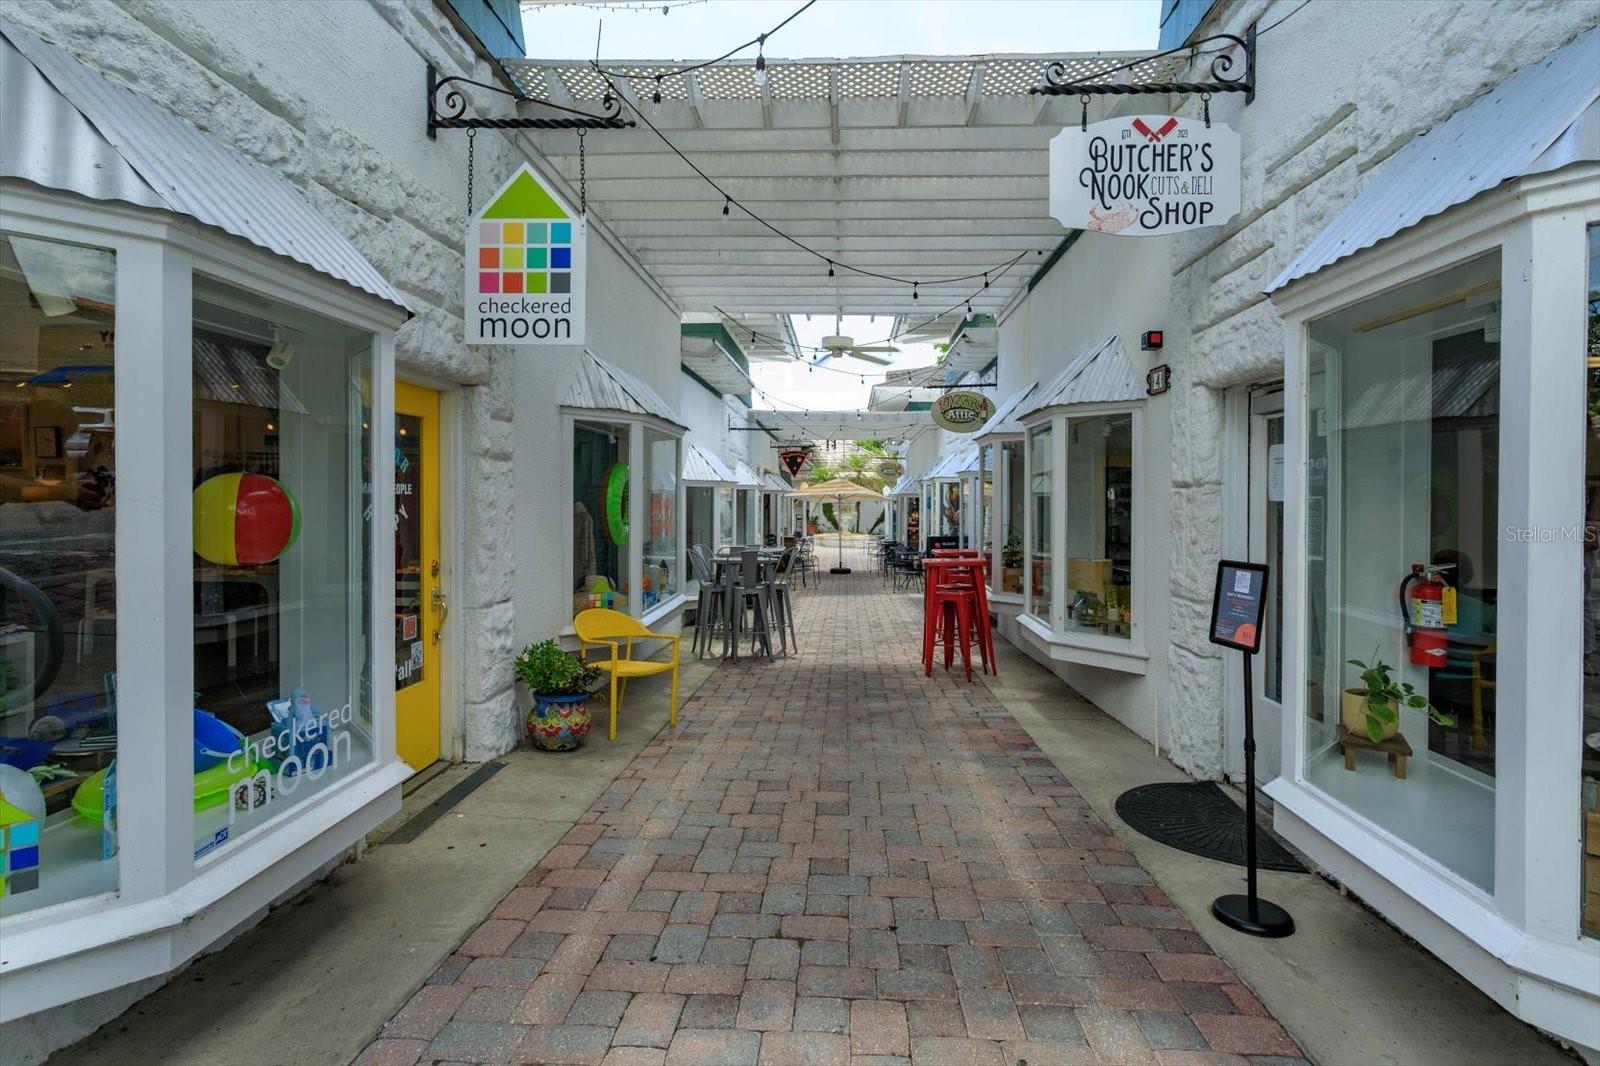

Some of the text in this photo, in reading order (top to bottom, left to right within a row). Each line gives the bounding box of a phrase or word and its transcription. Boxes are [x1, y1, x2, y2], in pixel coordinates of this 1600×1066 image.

[1089, 136, 1214, 173] BUTCHER'S
[1079, 167, 1150, 210] NOOK
[1140, 197, 1214, 229] SHOP
[478, 297, 571, 314] checkered
[480, 317, 571, 338] moon
[227, 695, 352, 774] checkered
[228, 730, 351, 825] moon
